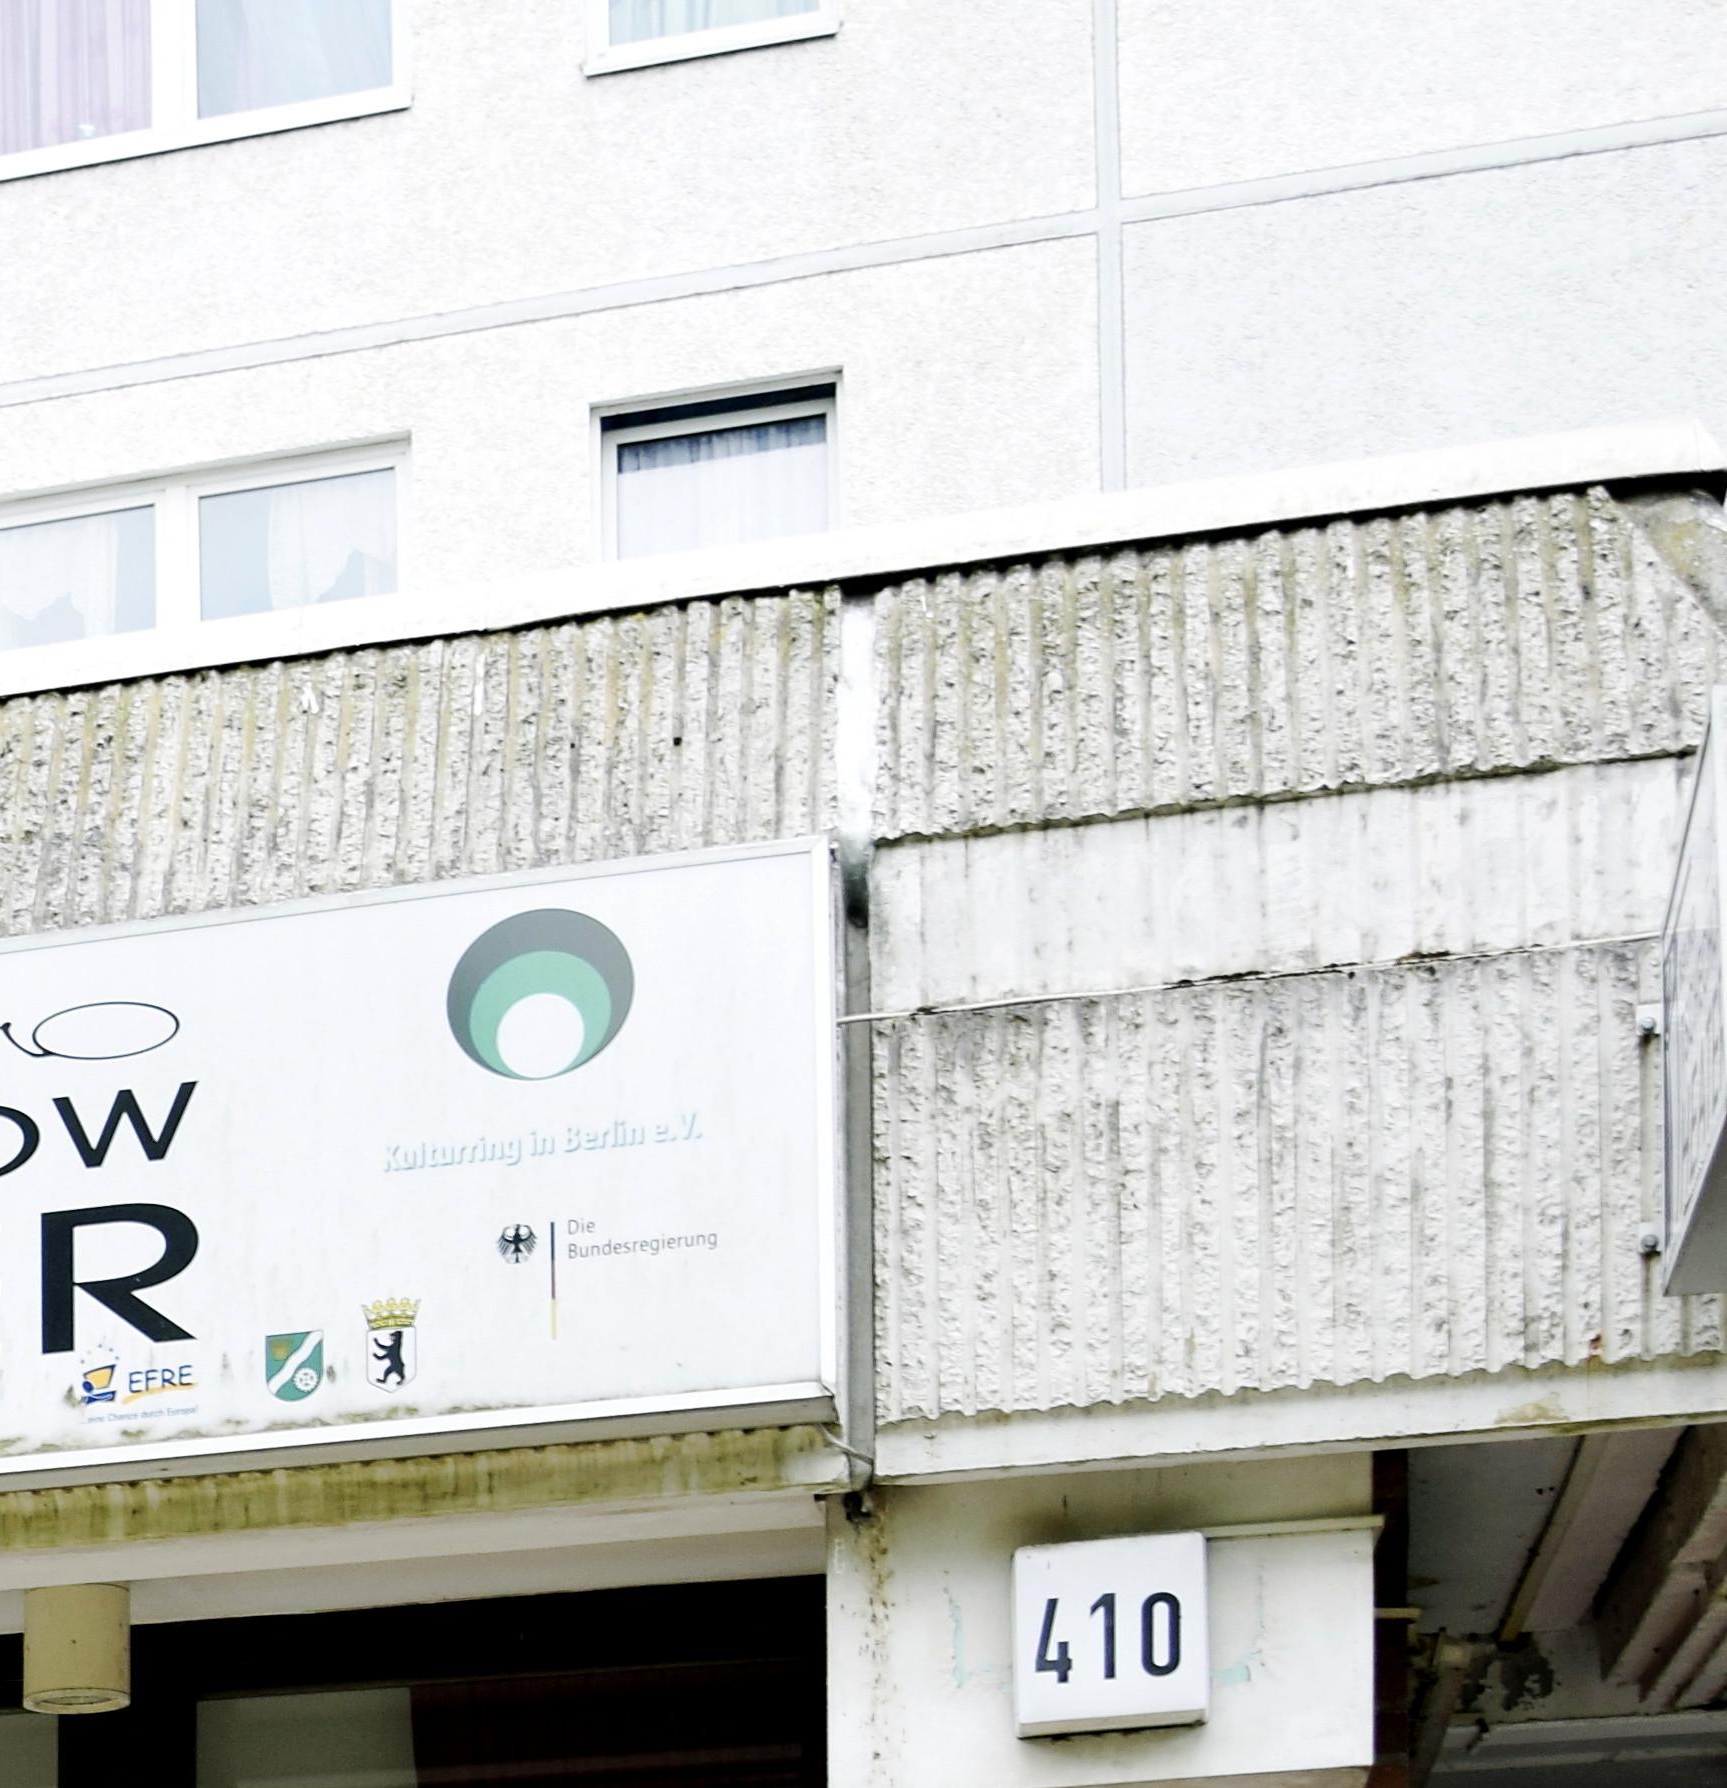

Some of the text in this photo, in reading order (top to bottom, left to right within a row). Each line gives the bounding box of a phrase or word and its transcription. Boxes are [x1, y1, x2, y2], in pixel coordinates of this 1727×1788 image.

[384, 1136, 522, 1173] Kulturring
[530, 1131, 555, 1157] in
[564, 1119, 645, 1153] Berlin
[567, 1218, 595, 1236] Die
[567, 1231, 718, 1260] Bundesregierung
[128, 1364, 193, 1394] EFRE
[1035, 1592, 1181, 1683] 410
